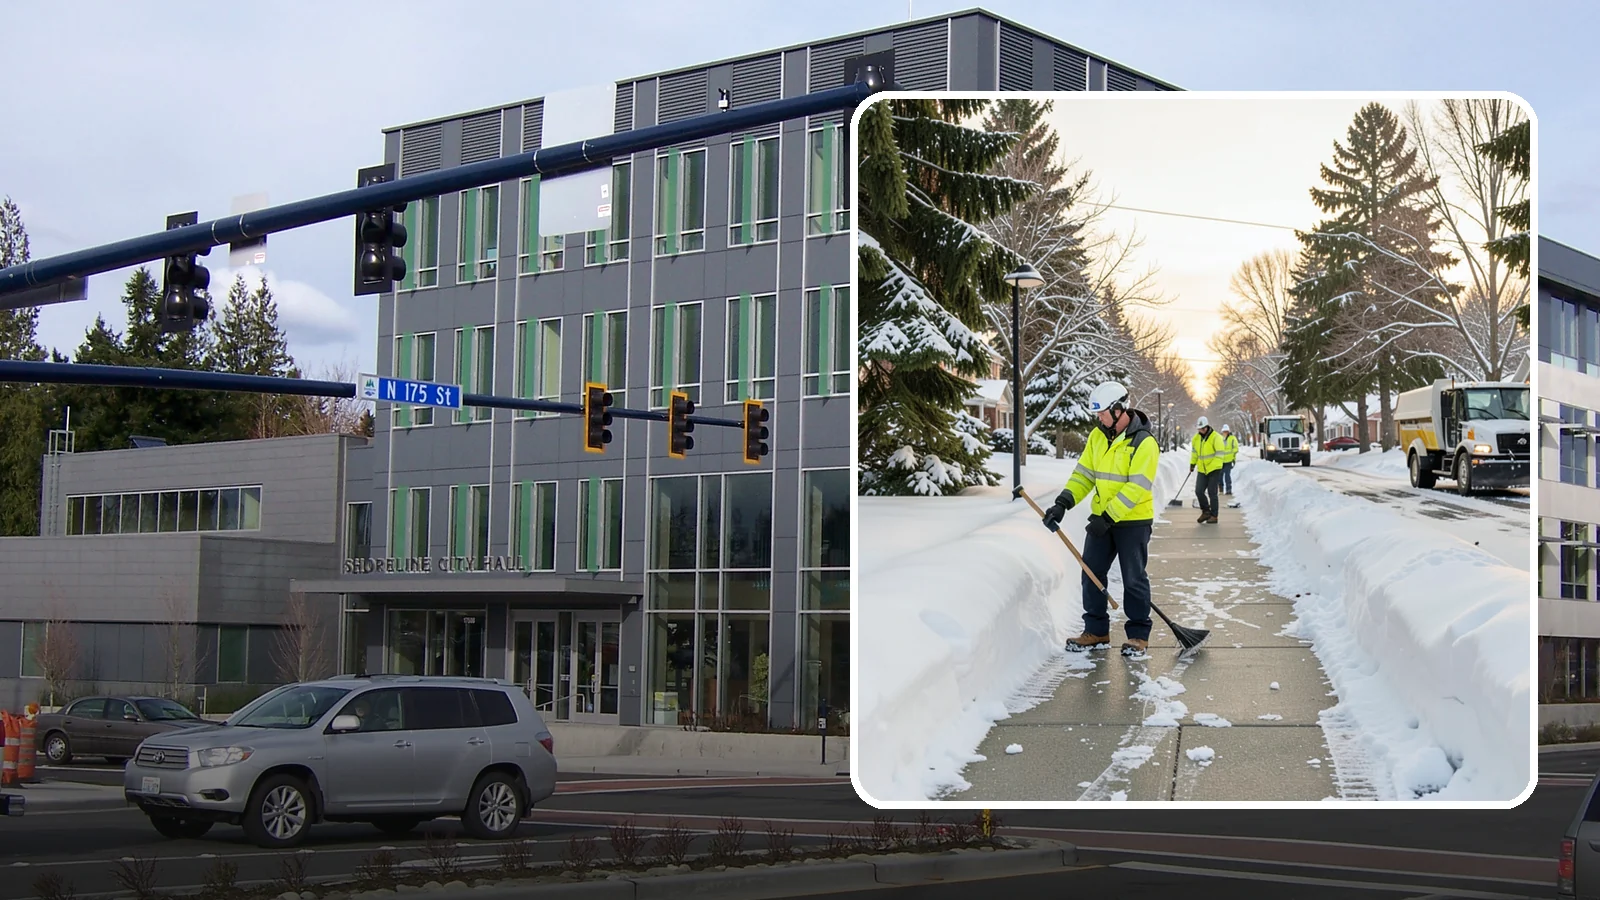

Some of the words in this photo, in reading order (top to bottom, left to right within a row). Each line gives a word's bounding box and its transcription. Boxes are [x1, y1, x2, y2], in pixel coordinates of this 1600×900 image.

[387, 380, 396, 399] N
[405, 383, 427, 402] 175
[436, 387, 451, 405] St
[344, 557, 432, 573] SHORELINE
[439, 556, 476, 571] CITY
[484, 556, 525, 571] HALL
